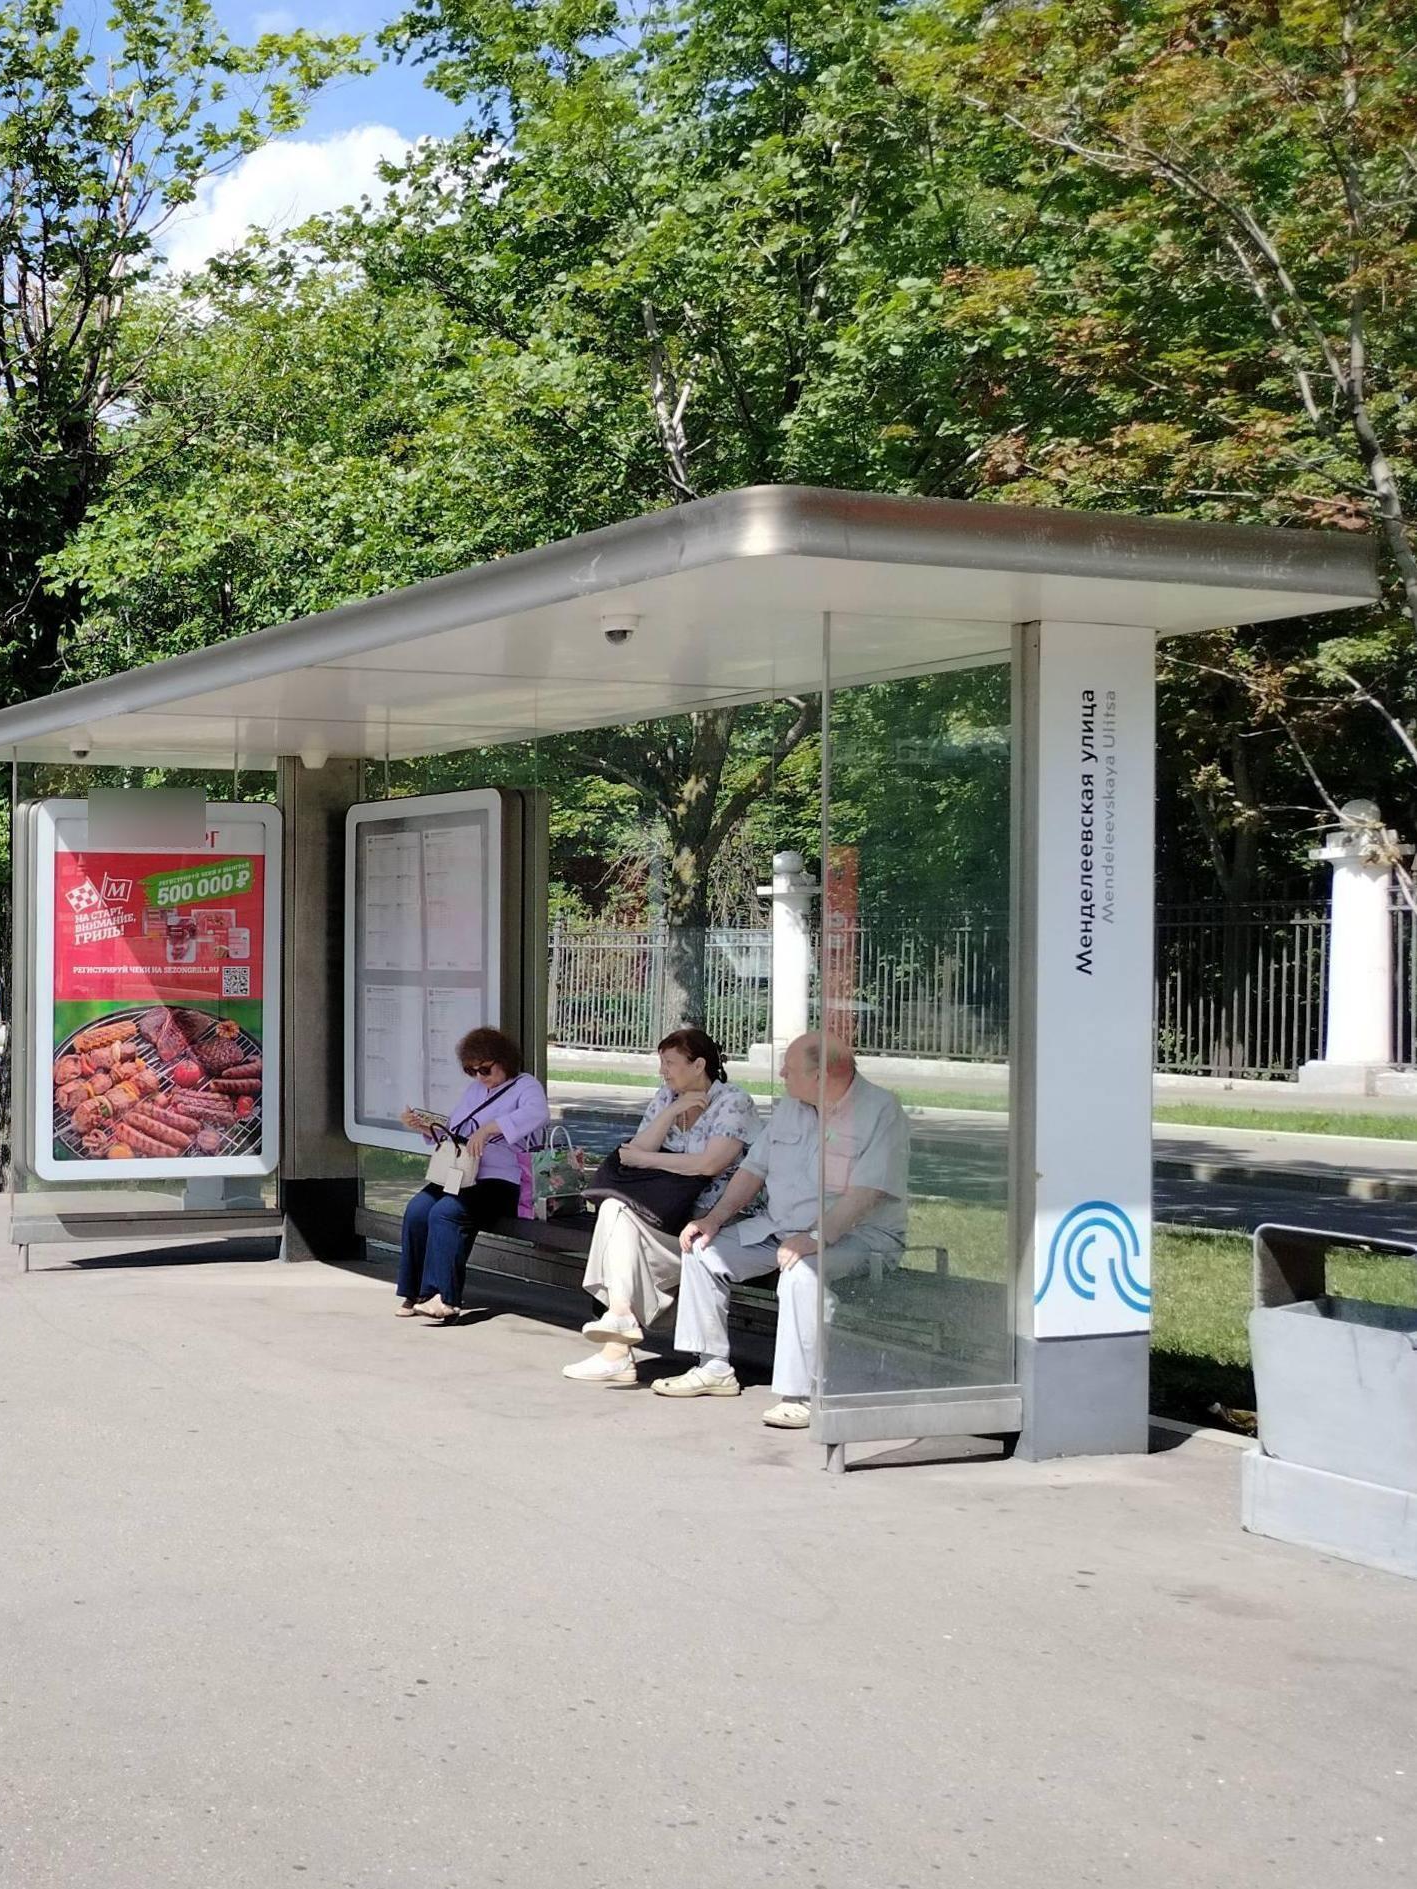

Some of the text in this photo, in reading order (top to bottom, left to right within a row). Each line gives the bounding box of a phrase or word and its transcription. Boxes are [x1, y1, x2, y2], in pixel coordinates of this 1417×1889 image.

[1100, 689, 1118, 924] Mendeleevskaya Ulitsa
[1075, 689, 1098, 976] Менделеевская улица
[157, 882, 194, 906] 500
[197, 873, 234, 898] 000
[75, 906, 124, 924] НА СТАРТ,
[75, 913, 136, 933] ВНИМАНИЕ,
[75, 925, 125, 946] ГРИЛЬ!
[73, 965, 220, 974] РЕГИСТРИРУЙ ЧЕКИ НА SEZONGRILL.RU
